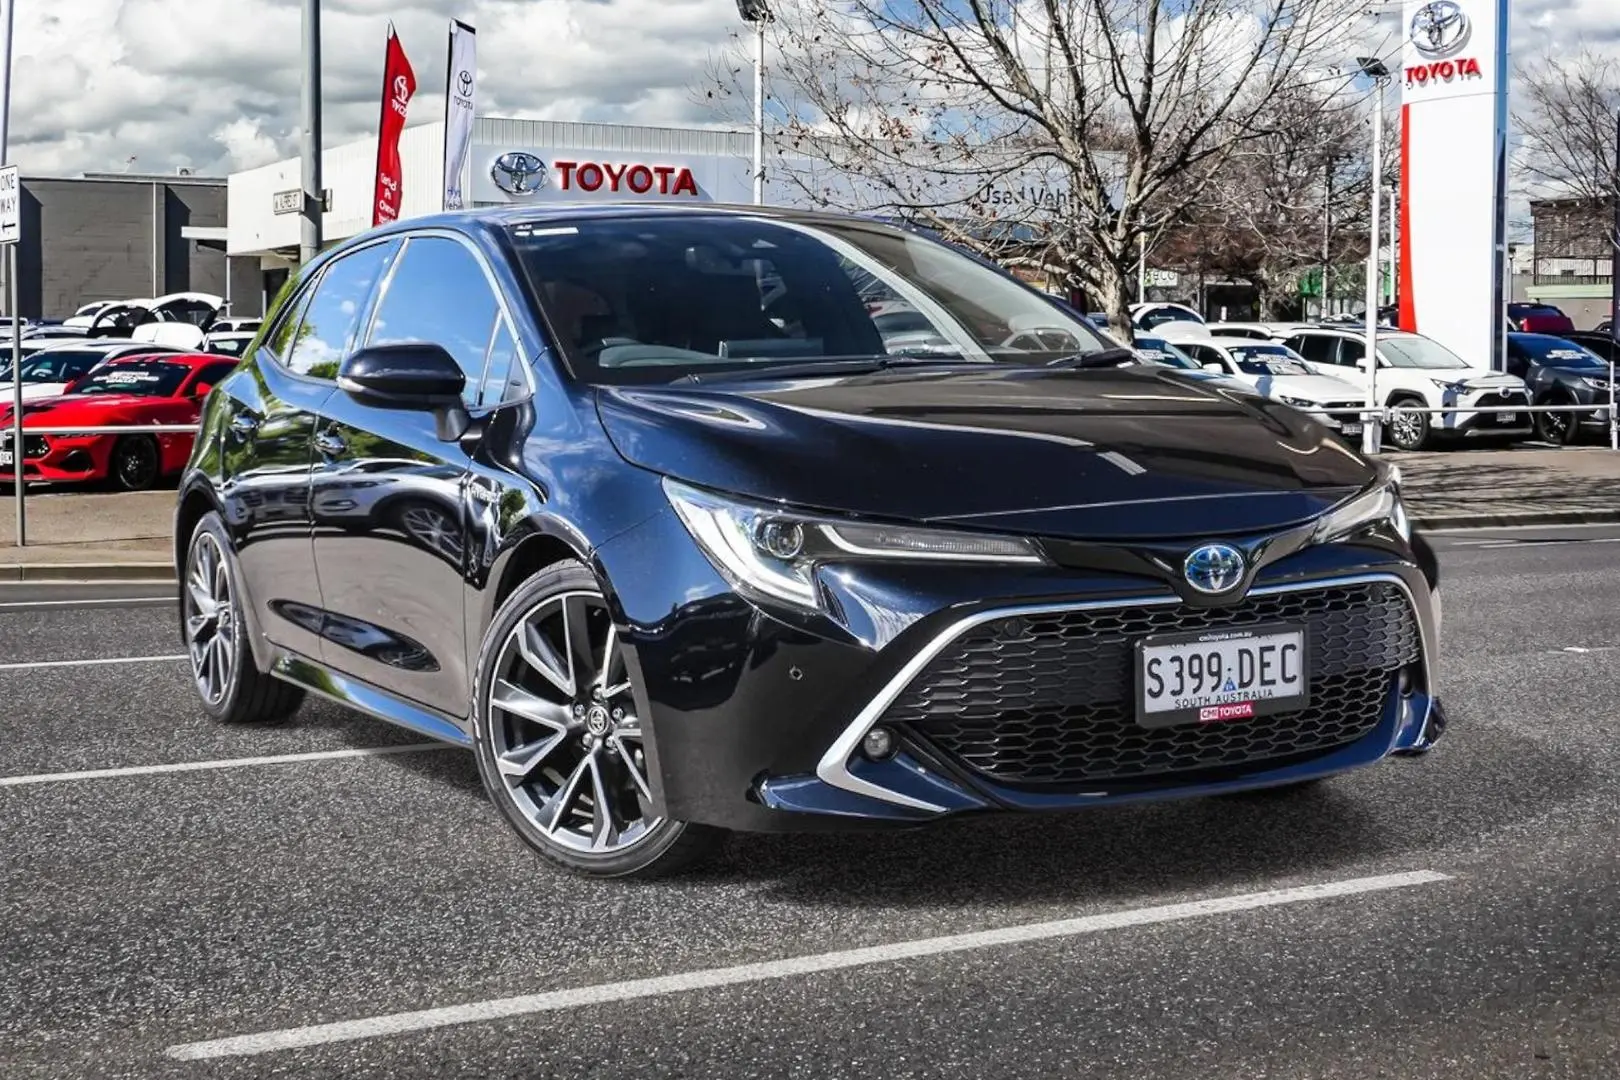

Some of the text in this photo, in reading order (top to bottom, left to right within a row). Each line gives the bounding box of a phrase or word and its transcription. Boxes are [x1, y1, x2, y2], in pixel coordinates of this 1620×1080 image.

[1404, 57, 1480, 83] TOYOTA
[555, 161, 698, 196] TOYOTA
[1174, 689, 1274, 709] SOUTH AUSTRALIA
[1219, 705, 1253, 718] TOYOTA
